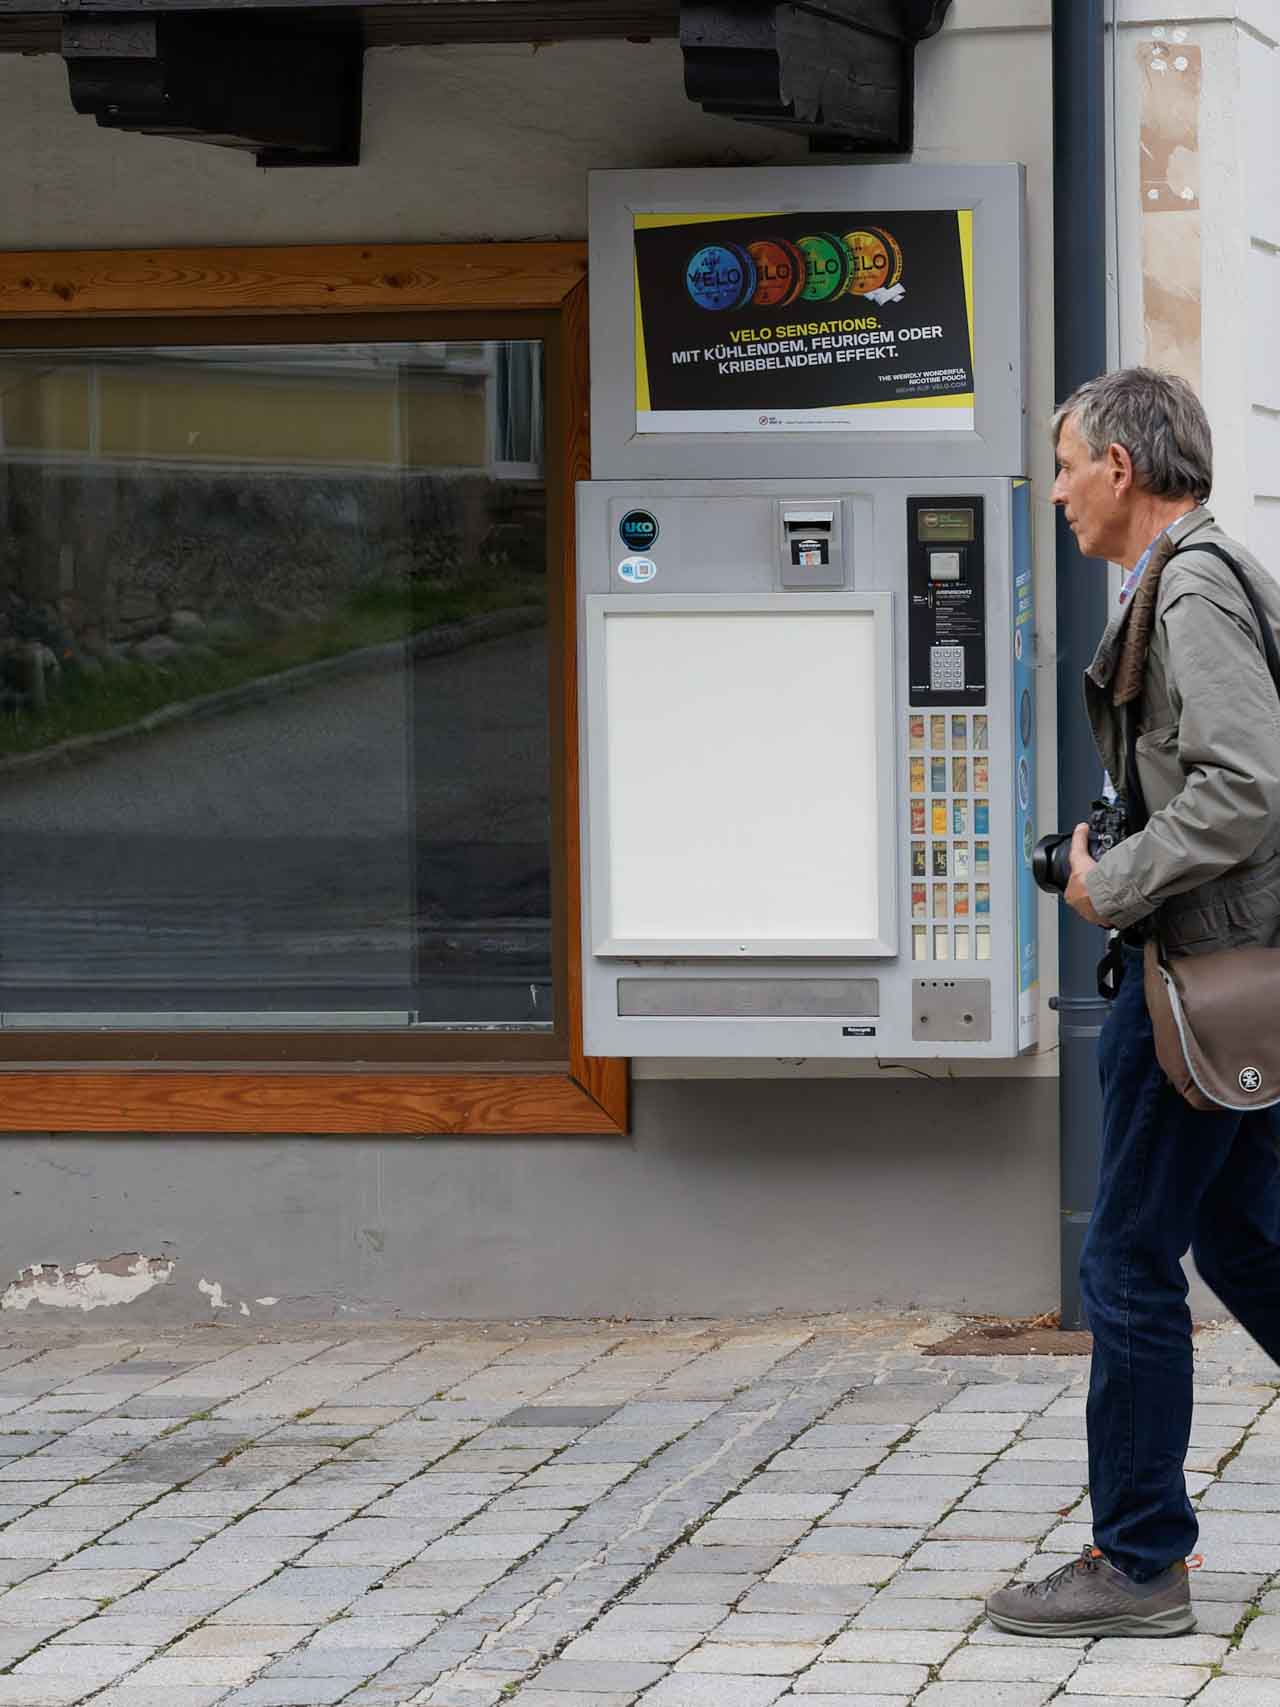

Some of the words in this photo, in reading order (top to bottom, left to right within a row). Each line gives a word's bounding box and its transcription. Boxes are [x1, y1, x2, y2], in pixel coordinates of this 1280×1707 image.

[805, 258, 839, 276] ELO
[852, 253, 887, 272] ELO
[688, 268, 740, 287] VELO
[730, 327, 772, 343] VELO
[776, 316, 881, 339] SENSATIONS.
[672, 350, 700, 364] MIT
[704, 338, 808, 361] KÜHLENDEM,
[812, 330, 894, 350] FEURIGEM
[898, 325, 944, 342] ODER
[718, 354, 832, 375] KRIBBELNDEM
[836, 345, 899, 364] EFFEKT.
[909, 377, 941, 385] NICOTINE
[942, 374, 967, 382] POUCH
[923, 368, 966, 378] WONDERFUL
